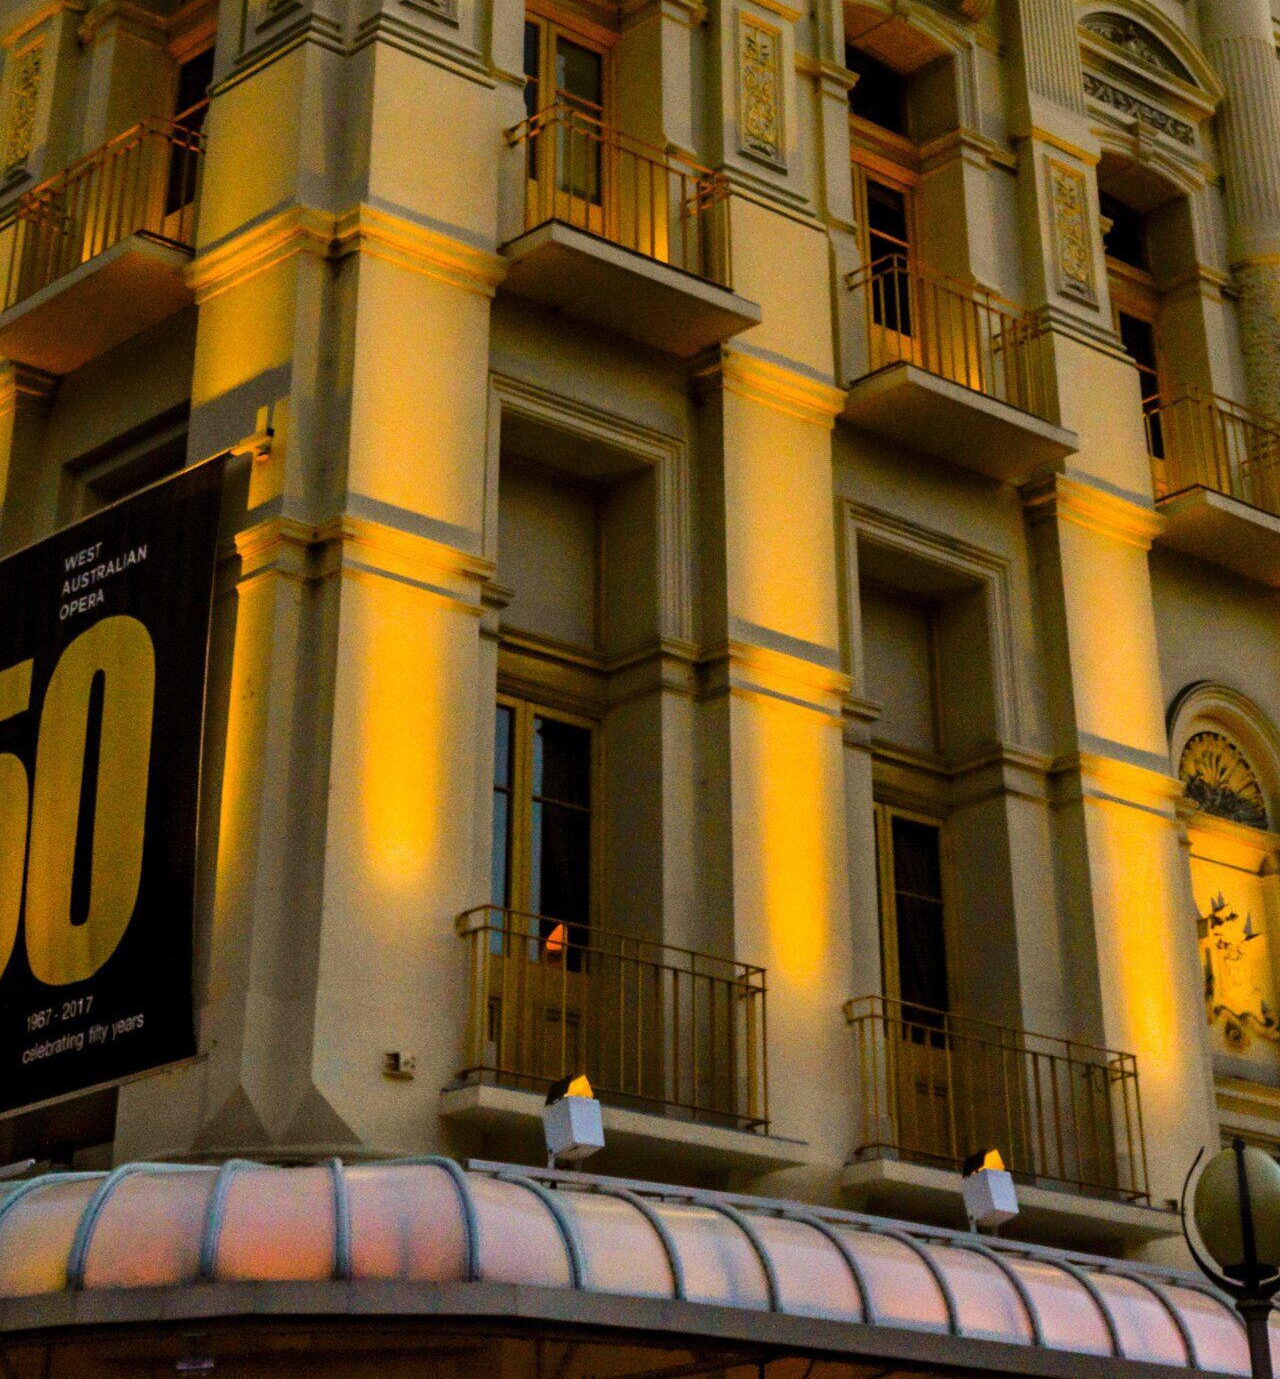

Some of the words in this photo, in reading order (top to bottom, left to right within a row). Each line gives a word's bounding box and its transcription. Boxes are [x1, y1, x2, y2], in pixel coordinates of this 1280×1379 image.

[60, 543, 149, 598] AUSTRALIAN
[64, 541, 103, 572] WEST
[59, 588, 105, 621] OPERA
[27, 1007, 52, 1031] 1967
[61, 995, 94, 1021] 2017
[22, 1032, 84, 1064] celebrating
[88, 1024, 108, 1044] fifty
[111, 1012, 145, 1041] years
